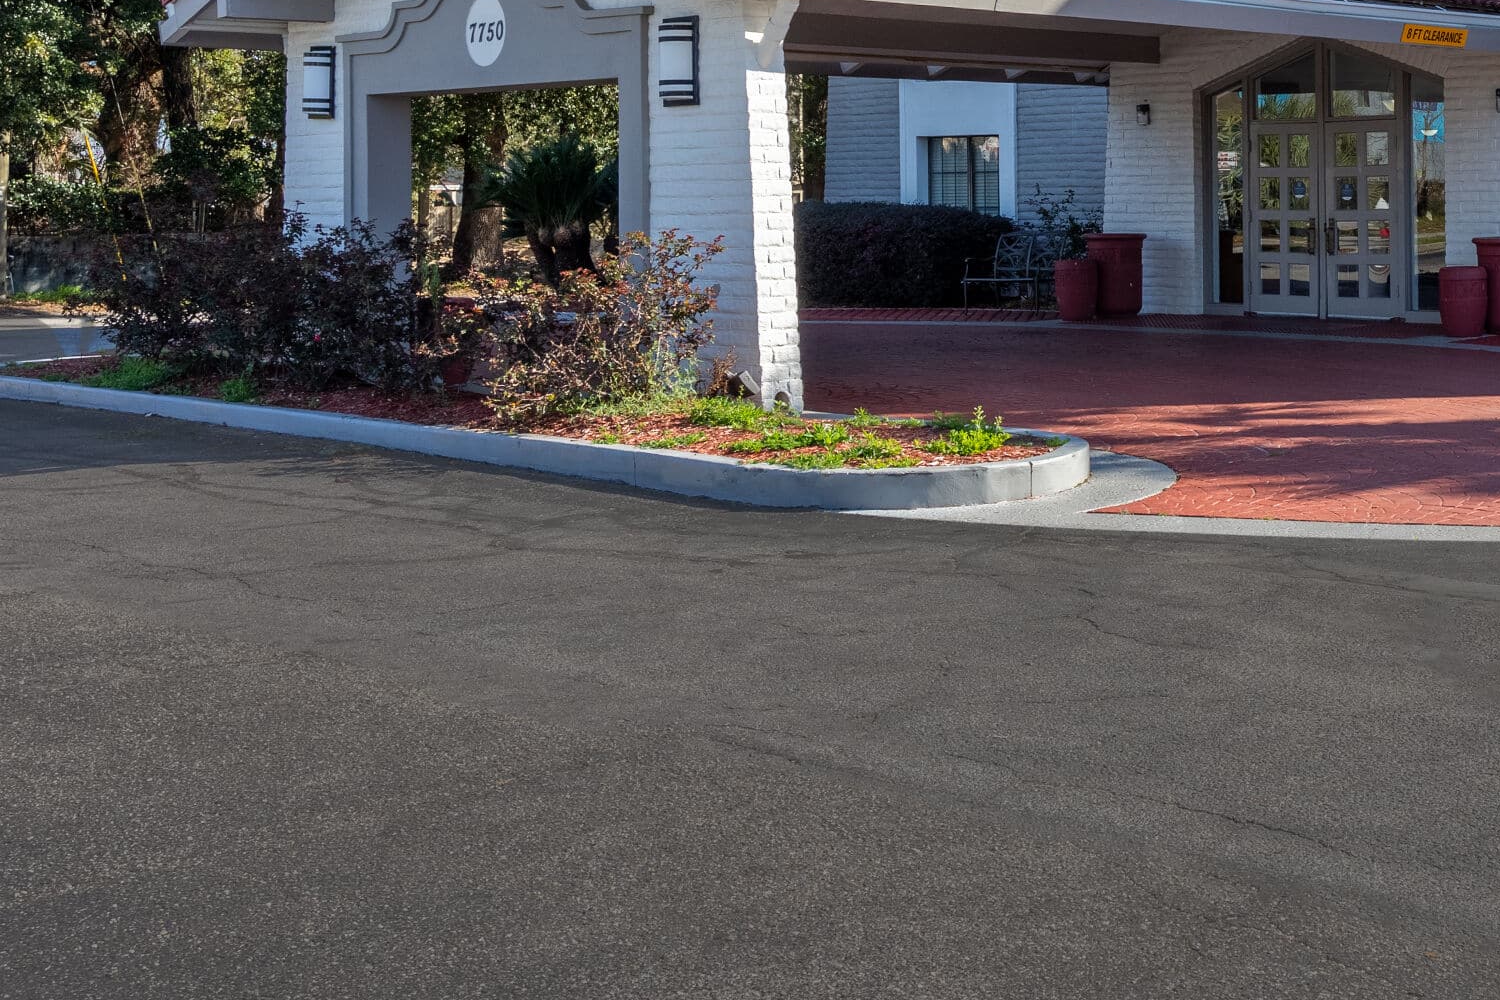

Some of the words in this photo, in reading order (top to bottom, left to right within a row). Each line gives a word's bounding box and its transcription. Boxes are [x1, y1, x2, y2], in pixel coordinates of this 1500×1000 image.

[469, 20, 504, 43] 7750
[1406, 28, 1412, 39] 8
[1413, 28, 1422, 40] FT
[1423, 30, 1463, 43] CLEARANCE
